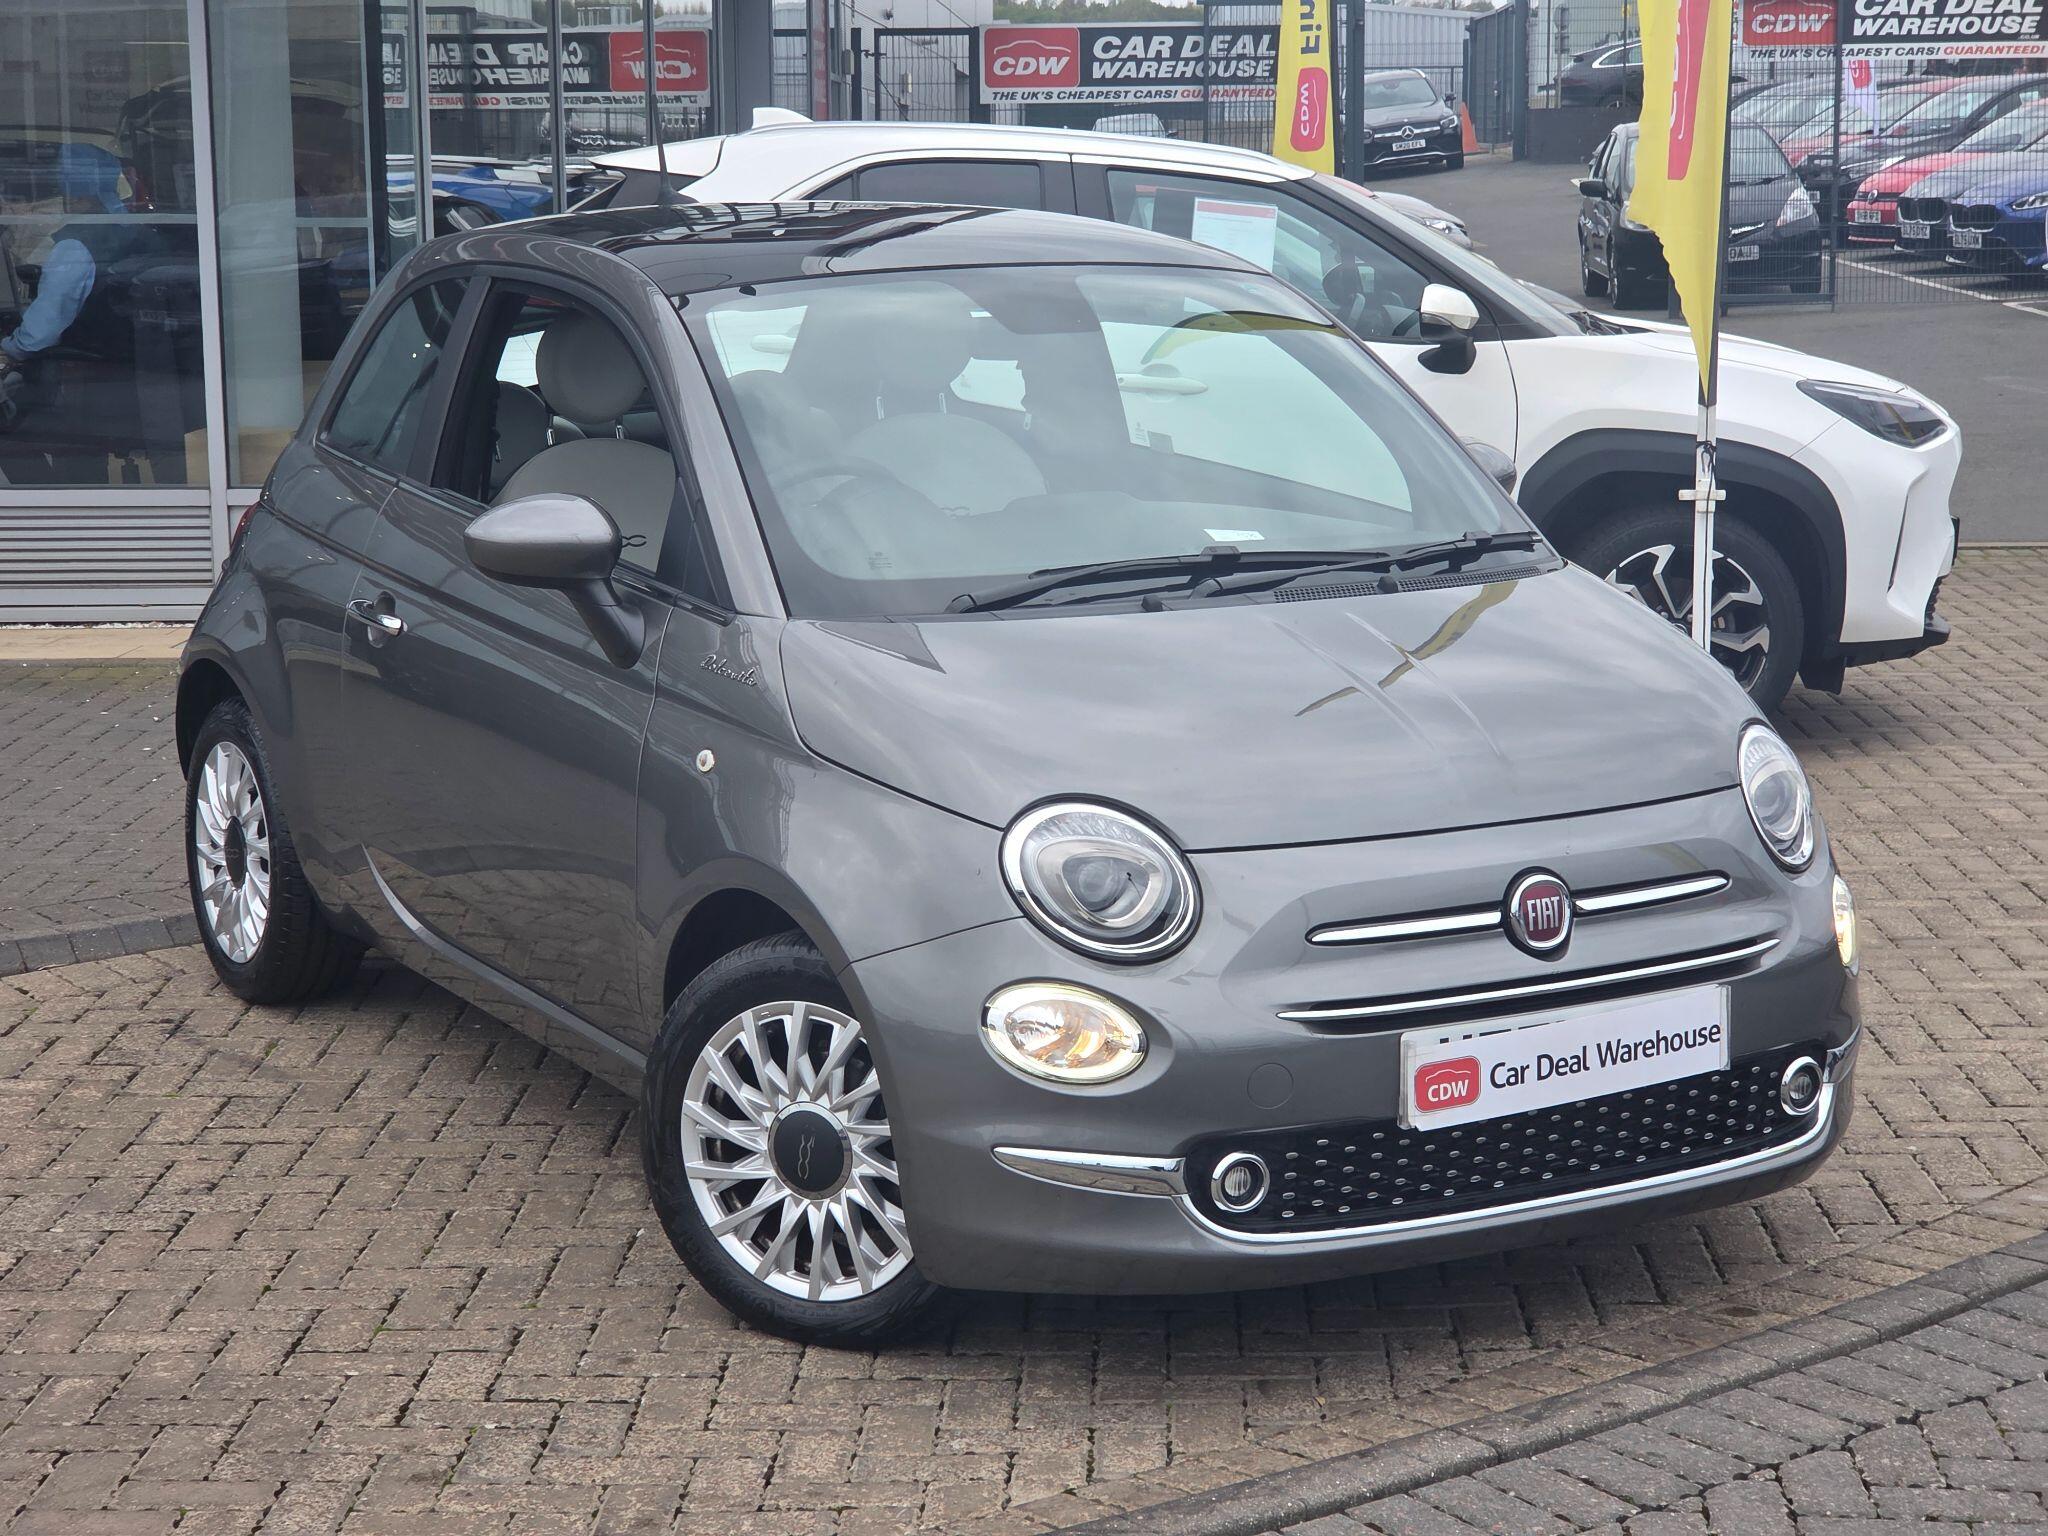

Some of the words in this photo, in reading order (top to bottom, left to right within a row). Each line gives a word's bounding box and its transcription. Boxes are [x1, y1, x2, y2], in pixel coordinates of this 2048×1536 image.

[1855, 0, 1934, 16] CAR
[1943, 0, 2044, 14] DEAL
[1751, 13, 1831, 33] CDW
[1853, 16, 2040, 36] WAREHOUSE
[1093, 35, 1174, 59] CAR
[1180, 34, 1275, 58] DEAL
[1750, 49, 1777, 58] THE
[1780, 48, 1813, 58] UK'S
[1895, 46, 1940, 56] CARS!
[1943, 45, 2045, 56] GUARANTEED!
[993, 56, 1070, 75] CDW
[1092, 59, 1274, 79] WAREHOUSE
[992, 91, 1018, 101] THE
[1021, 91, 1054, 100] UK'S
[1057, 90, 1131, 100] CHEAPEST
[1134, 89, 1178, 99] CARS!
[1181, 88, 1275, 98] GURANTEED
[1300, 82, 1310, 136] CDW
[1526, 895, 1560, 931] FIAT
[1490, 1061, 1529, 1089] Car
[1536, 1045, 1590, 1082] Deal
[1596, 1023, 1721, 1068] Warehouse
[1427, 1079, 1470, 1103] CDW
